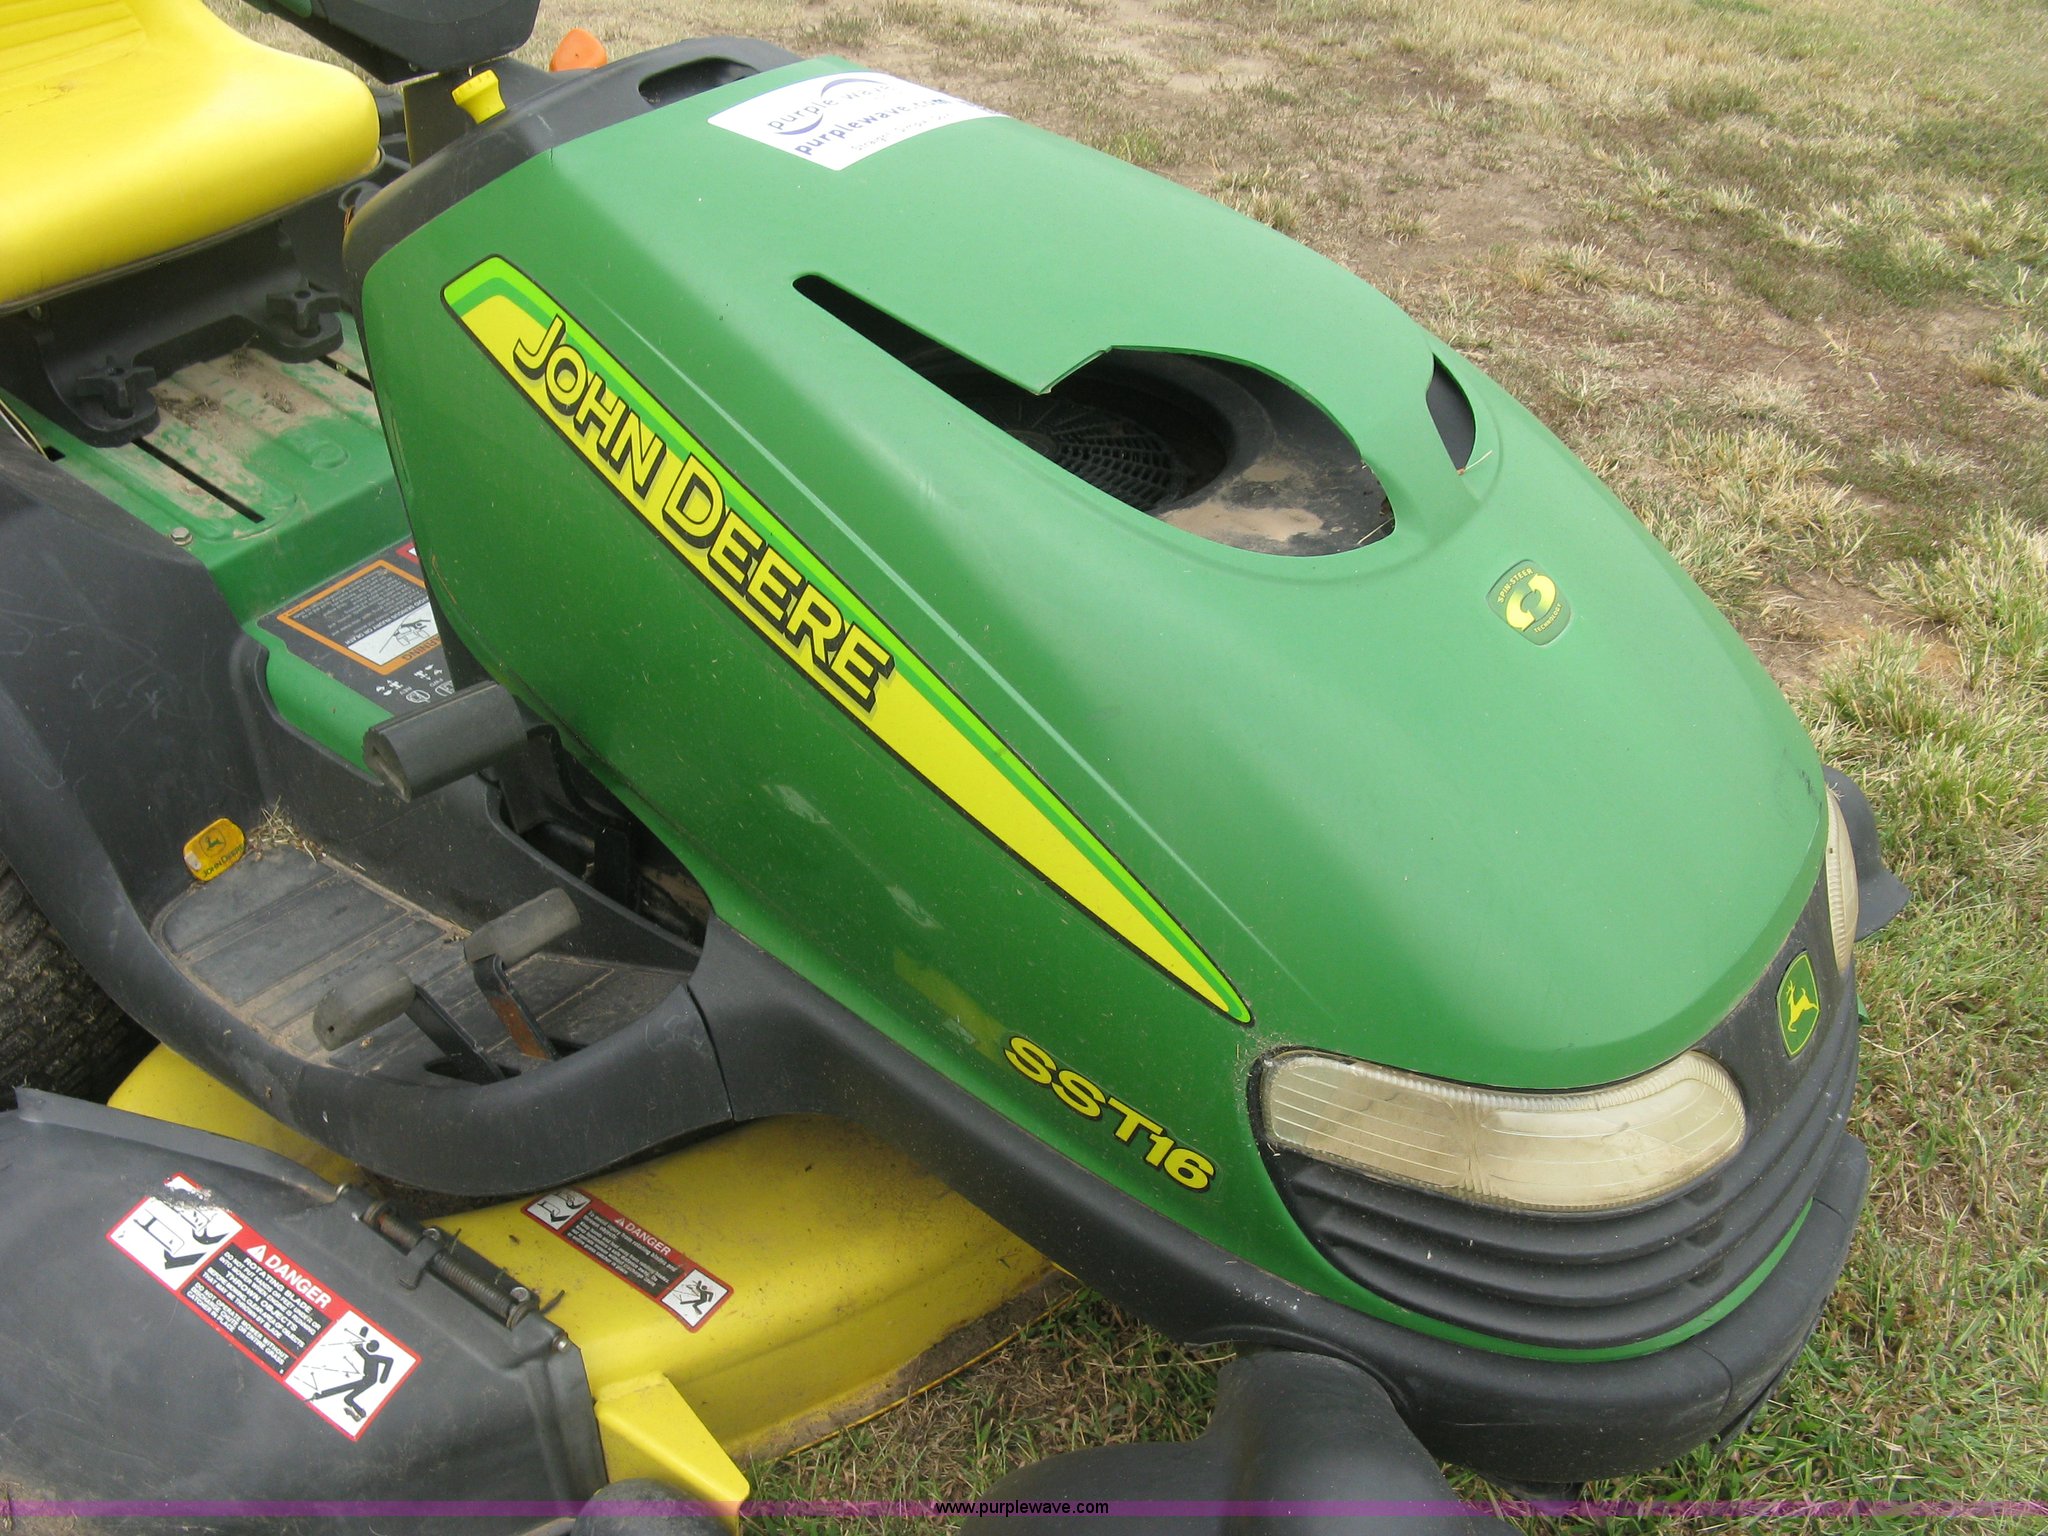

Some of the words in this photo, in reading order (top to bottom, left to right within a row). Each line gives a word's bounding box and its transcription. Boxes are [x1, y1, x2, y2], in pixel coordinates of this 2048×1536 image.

[768, 98, 838, 131] purple
[513, 314, 666, 500] JOHN
[662, 453, 896, 713] DEERE
[1534, 603, 1562, 632] TECHNOLOGY
[1004, 1036, 1216, 1193] SST16
[625, 1222, 671, 1255] DANGER
[185, 1290, 212, 1313] CATCHER
[209, 1310, 218, 1318] IN
[215, 1315, 236, 1332] PLACE
[200, 1271, 218, 1286] THAT
[214, 1282, 228, 1294] MAY
[225, 1291, 236, 1301] BE
[232, 1297, 258, 1319] THROWN
[254, 1315, 266, 1325] BY
[262, 1321, 283, 1339] BLADE
[206, 1266, 228, 1285] BEFORE
[244, 1297, 264, 1314] CLEAR
[260, 1310, 277, 1325] AREA
[273, 1321, 284, 1330] OF
[280, 1326, 306, 1348] OBJECTS
[217, 1255, 233, 1269] INTO
[230, 1265, 253, 1285] MOWER
[249, 1281, 268, 1297] WHEN
[265, 1293, 287, 1312] ENGINE
[284, 1309, 293, 1317] IS
[289, 1313, 316, 1336] RUNNING
[222, 1250, 234, 1261] DO
[231, 1257, 246, 1270] NOT
[242, 1266, 256, 1278] PUT
[252, 1274, 273, 1292] HANDS
[270, 1289, 282, 1299] OR
[278, 1295, 295, 1310] FEET
[292, 1306, 313, 1324] UNDER
[309, 1320, 321, 1331] OR
[223, 1270, 262, 1302] THROWN
[258, 1298, 298, 1332] OBJECTS
[242, 1256, 285, 1292] ROTATING
[282, 1289, 312, 1314] BLADE
[264, 1254, 332, 1309] DANGER
[189, 1285, 222, 1313] DISCHARGE
[218, 1309, 239, 1327] CHUTE
[236, 1324, 248, 1334] OR
[244, 1331, 267, 1350] ENTIRE
[263, 1346, 285, 1365] GRASS
[193, 1281, 205, 1292] DO
[202, 1288, 216, 1301] NOT
[214, 1298, 242, 1322] OPERATE
[239, 1319, 264, 1340] MOWER
[260, 1336, 289, 1360] WITHOUT
